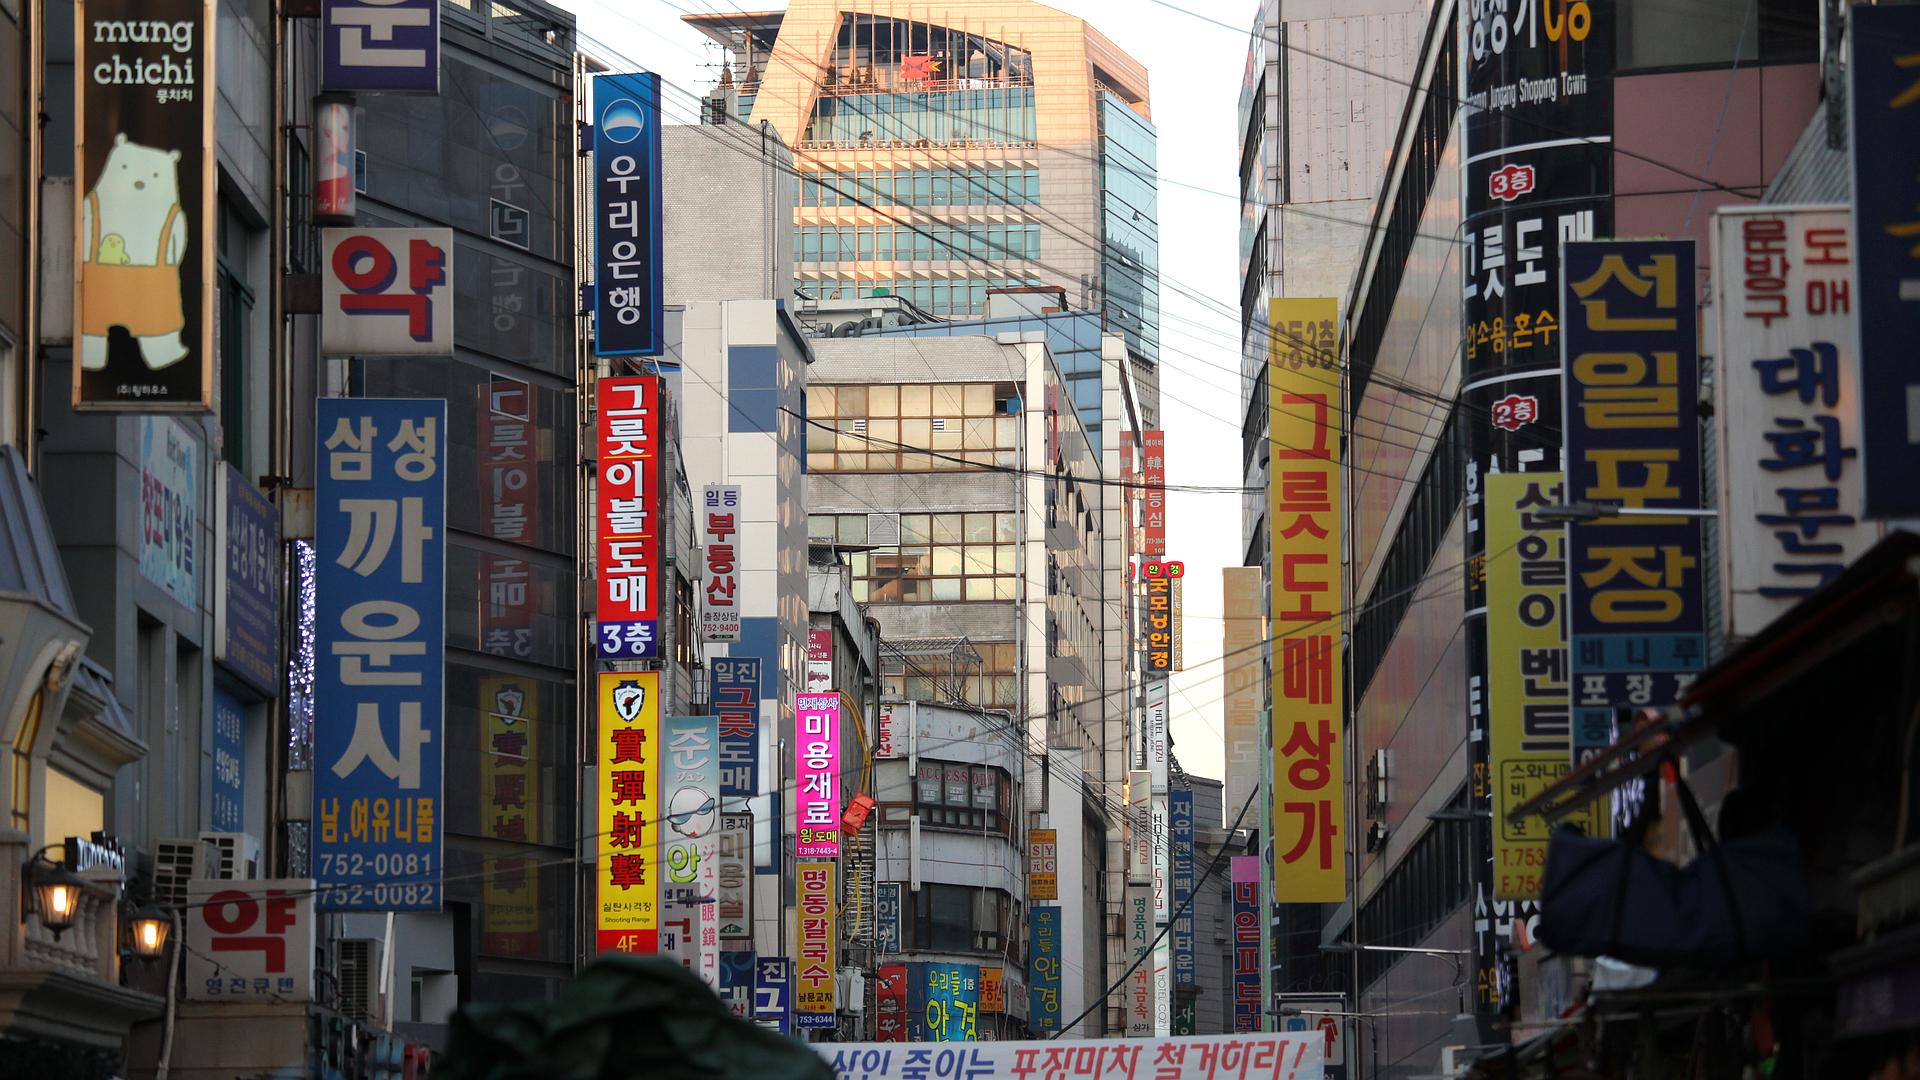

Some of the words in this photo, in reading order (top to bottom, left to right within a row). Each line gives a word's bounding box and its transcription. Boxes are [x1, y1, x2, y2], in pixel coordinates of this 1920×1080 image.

[94, 20, 194, 52] mung
[94, 55, 195, 84] chichi
[156, 89, 193, 104] 뭉치치
[1519, 77, 1557, 105] Shopping
[1561, 72, 1587, 96] Town
[1493, 171, 1530, 194] 3층
[607, 155, 641, 325] 우리은행
[1743, 219, 1791, 328] 문방구
[1803, 227, 1851, 315] 도매
[333, 235, 446, 342] 약
[1496, 403, 1533, 424] 2층
[325, 416, 436, 481] 삼성
[1570, 254, 1697, 623] 선일포장
[1751, 341, 1857, 600] 대화문구
[606, 384, 648, 613] 그릇이불도매
[706, 490, 738, 507] 일등
[707, 513, 736, 606] 부동산
[704, 612, 738, 621] 출장상담
[1279, 393, 1337, 870] 그릇도매상가
[331, 497, 432, 789] 까운사
[603, 623, 652, 655] 3층
[714, 662, 757, 684] 일진
[1155, 709, 1163, 736] HOTEL
[669, 727, 711, 770] 준
[714, 687, 754, 791] 그릇도매
[803, 714, 833, 824] 미용재료
[321, 797, 433, 843] 남.여유니폼
[610, 726, 647, 891] 實彈射擊
[720, 818, 747, 830] 경자
[800, 829, 813, 844] 왕
[815, 831, 837, 843] 도매
[1154, 813, 1162, 866] HOTEL
[320, 853, 432, 876] 752-0081
[1502, 849, 1544, 867] T.753
[320, 883, 433, 905] 752-0082
[603, 902, 651, 913] 실탄사격장
[203, 889, 296, 973] 약
[605, 916, 631, 924] Shooting
[632, 915, 650, 924] Range
[802, 870, 829, 987] 명동칼국수
[616, 935, 638, 953] 4F
[206, 978, 293, 995] 영진큐텐
[757, 961, 786, 984] 진
[928, 970, 960, 996] 우리들
[1034, 957, 1060, 1013] 안경
[1133, 1024, 1149, 1032] 상가
[901, 1048, 996, 1080] 죽이는
